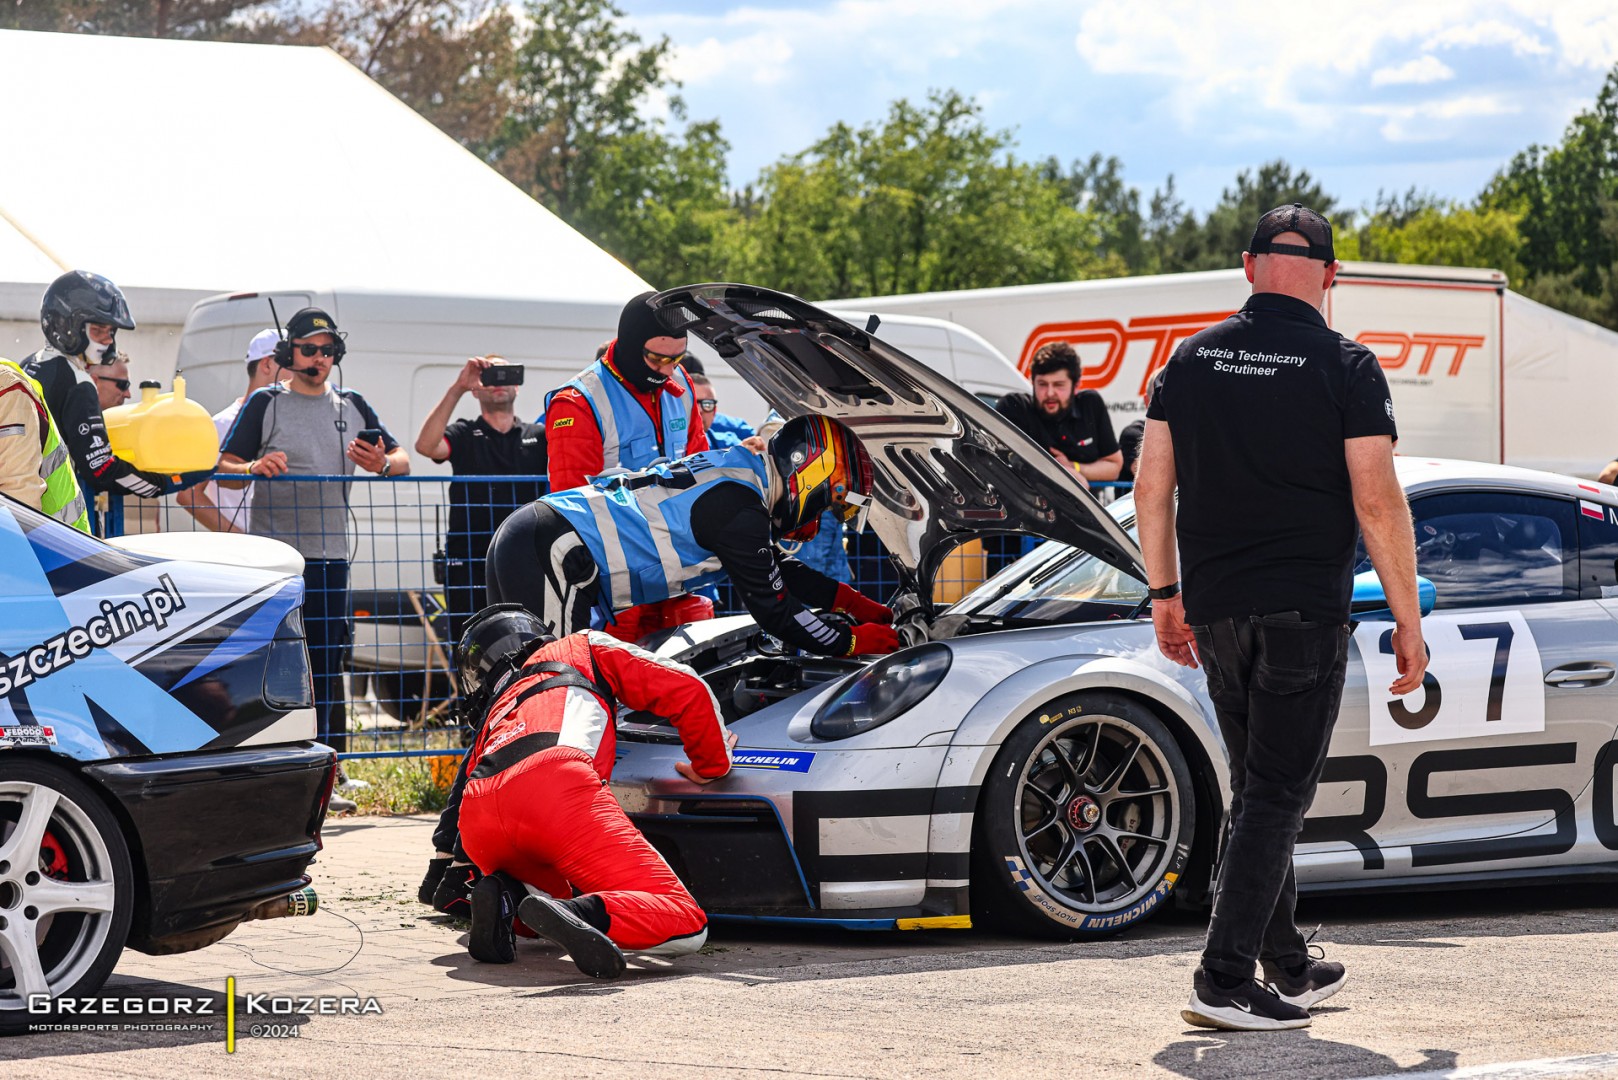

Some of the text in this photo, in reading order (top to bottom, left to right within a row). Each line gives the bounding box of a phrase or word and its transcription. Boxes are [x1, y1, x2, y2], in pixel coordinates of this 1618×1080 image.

[1196, 346, 1307, 367] Sędzia Techniczny
[1213, 360, 1278, 376] Scrutineer
[731, 755, 800, 766] MICHELIN
[1087, 894, 1158, 930] MICHELIN
